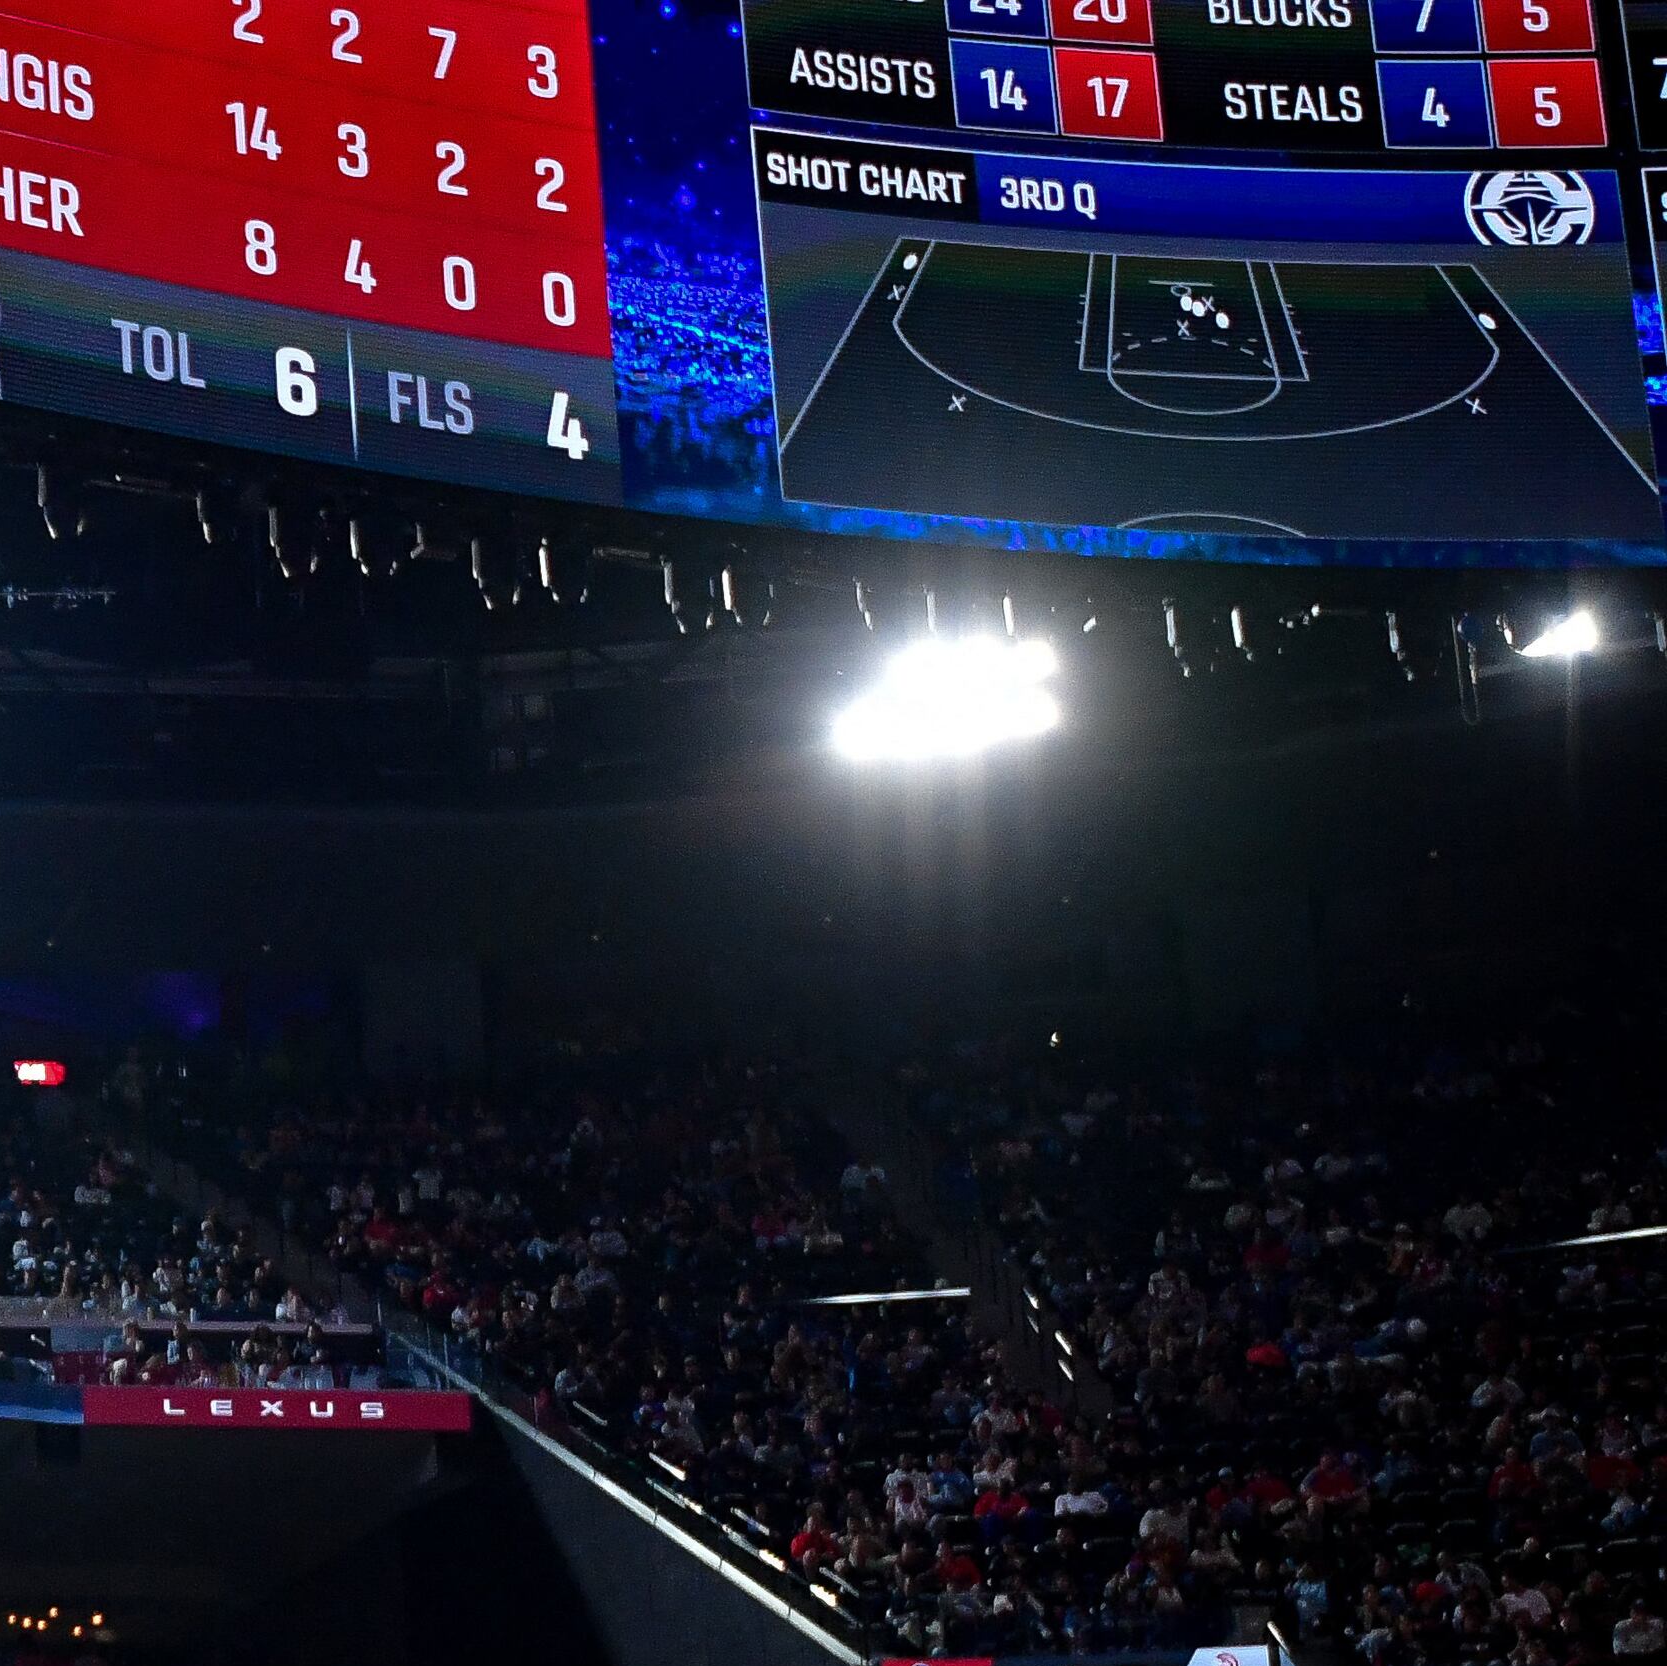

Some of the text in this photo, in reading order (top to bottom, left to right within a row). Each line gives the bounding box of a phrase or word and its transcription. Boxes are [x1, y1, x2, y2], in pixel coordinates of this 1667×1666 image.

[233, 0, 559, 99] 2 2 7 3
[1208, 0, 1353, 28] BLOCKS
[1522, 0, 1551, 33] 5
[790, 47, 1130, 118] ASSISTS 14 17
[1223, 83, 1562, 128] STEALS 4 5
[225, 102, 282, 161] 14
[337, 123, 369, 178] 3
[436, 141, 469, 196] 2
[535, 158, 568, 212] 2
[766, 151, 967, 205] SHOT CHART
[1000, 176, 1097, 221] 3RD Q
[244, 219, 278, 275] 8
[344, 239, 377, 293] 4
[442, 256, 476, 311] 0
[542, 272, 576, 327] 0
[110, 317, 318, 418] TOL 6
[388, 372, 590, 461] FLS 4
[162, 1397, 385, 1421] LEXUS
